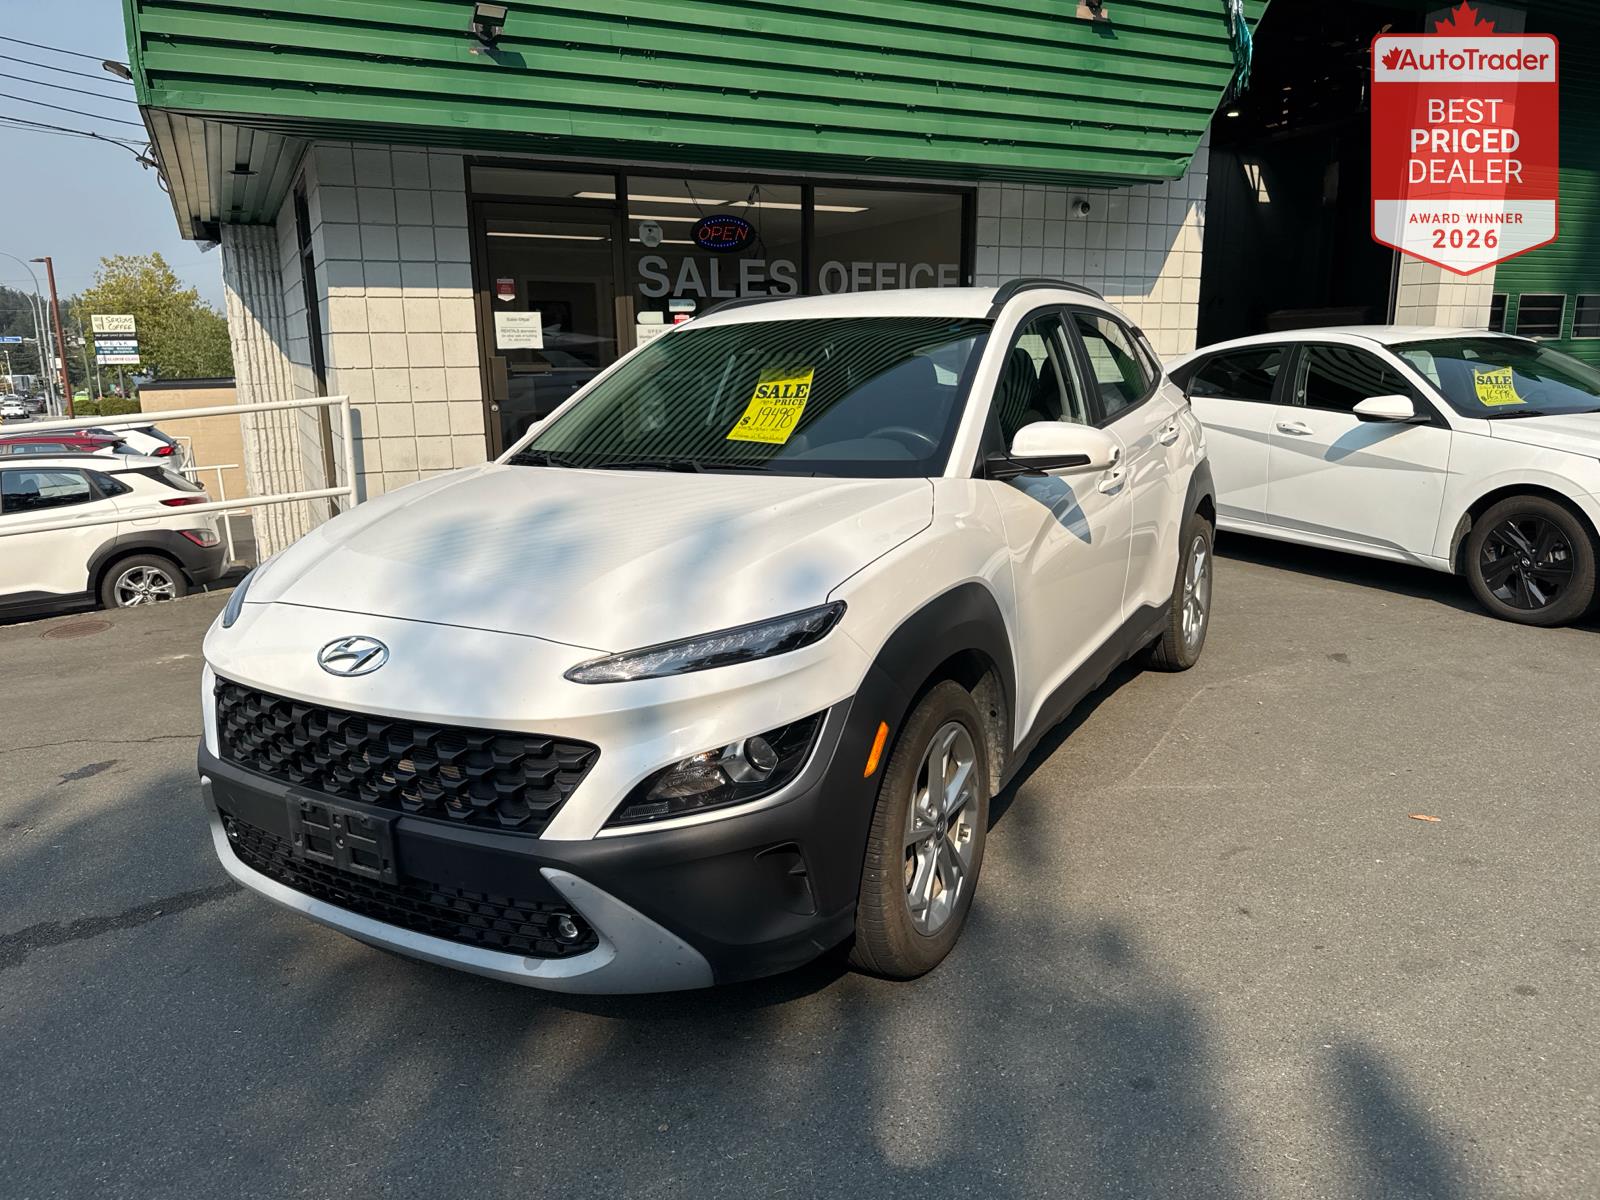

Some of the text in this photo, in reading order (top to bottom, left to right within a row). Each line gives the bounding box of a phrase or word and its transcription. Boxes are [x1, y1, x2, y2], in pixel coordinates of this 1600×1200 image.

[698, 225, 749, 241] OPEN
[638, 255, 960, 298] SALES OFFICE
[1476, 375, 1512, 385] SALE
[755, 384, 810, 399] SALE
